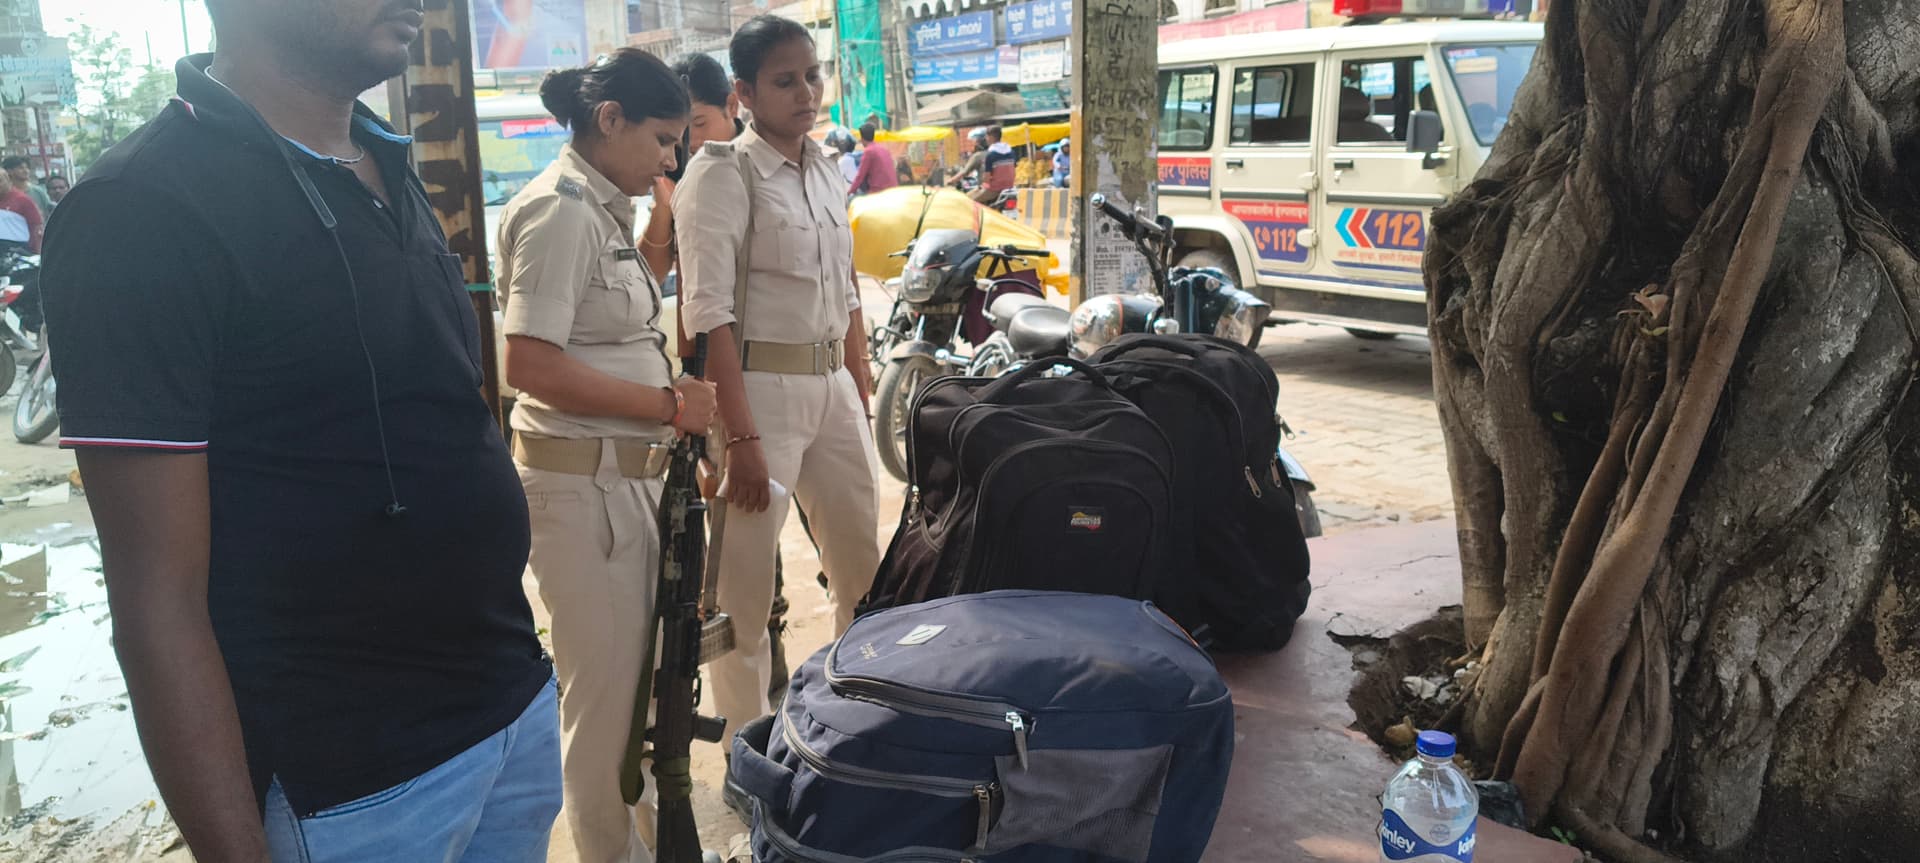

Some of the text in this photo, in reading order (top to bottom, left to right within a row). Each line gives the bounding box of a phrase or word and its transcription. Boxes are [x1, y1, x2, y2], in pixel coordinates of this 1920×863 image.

[1178, 159, 1209, 186] पुलिस
[1273, 228, 1297, 253] 112
[1374, 212, 1421, 247] 112
